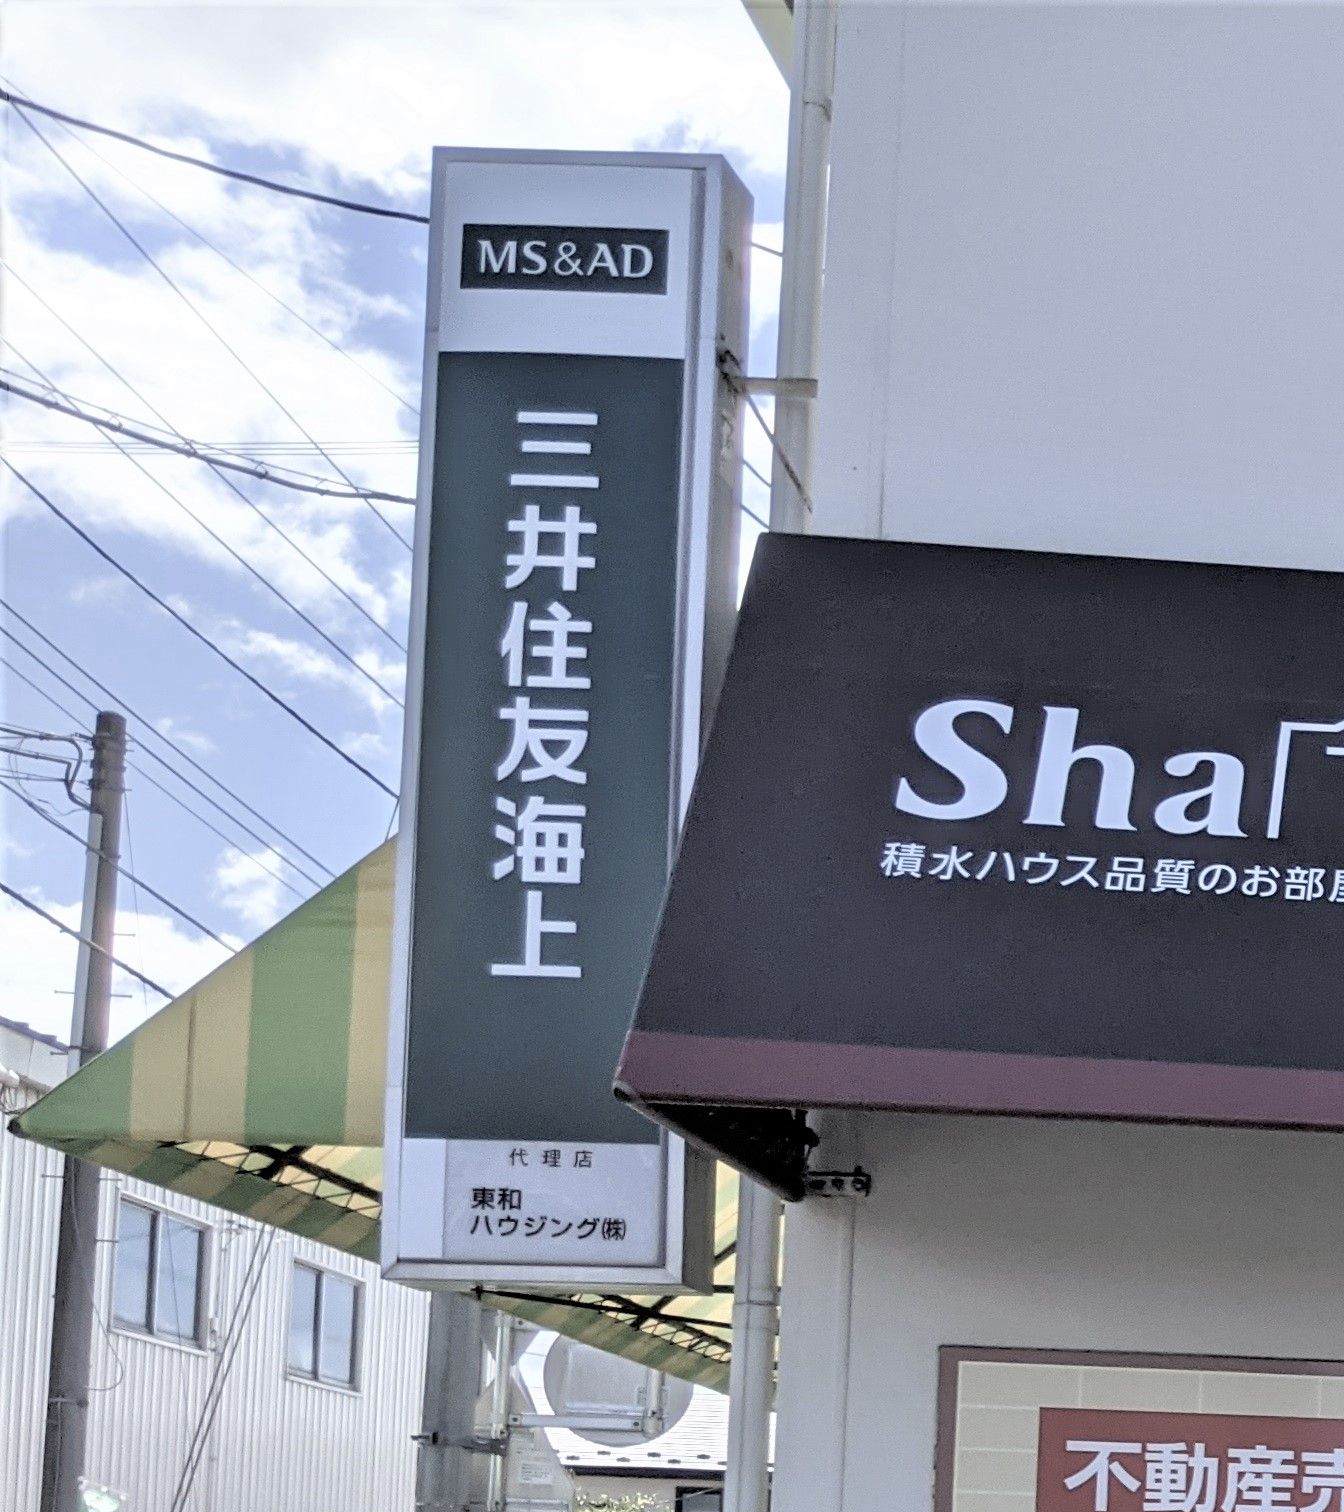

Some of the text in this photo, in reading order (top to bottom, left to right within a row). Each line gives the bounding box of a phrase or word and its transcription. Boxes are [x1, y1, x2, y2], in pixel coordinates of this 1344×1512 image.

[477, 239, 654, 279] MS&AD
[490, 410, 599, 979] 三井住友海上
[509, 1148, 594, 1169] 代理店
[470, 1186, 522, 1211] 東和
